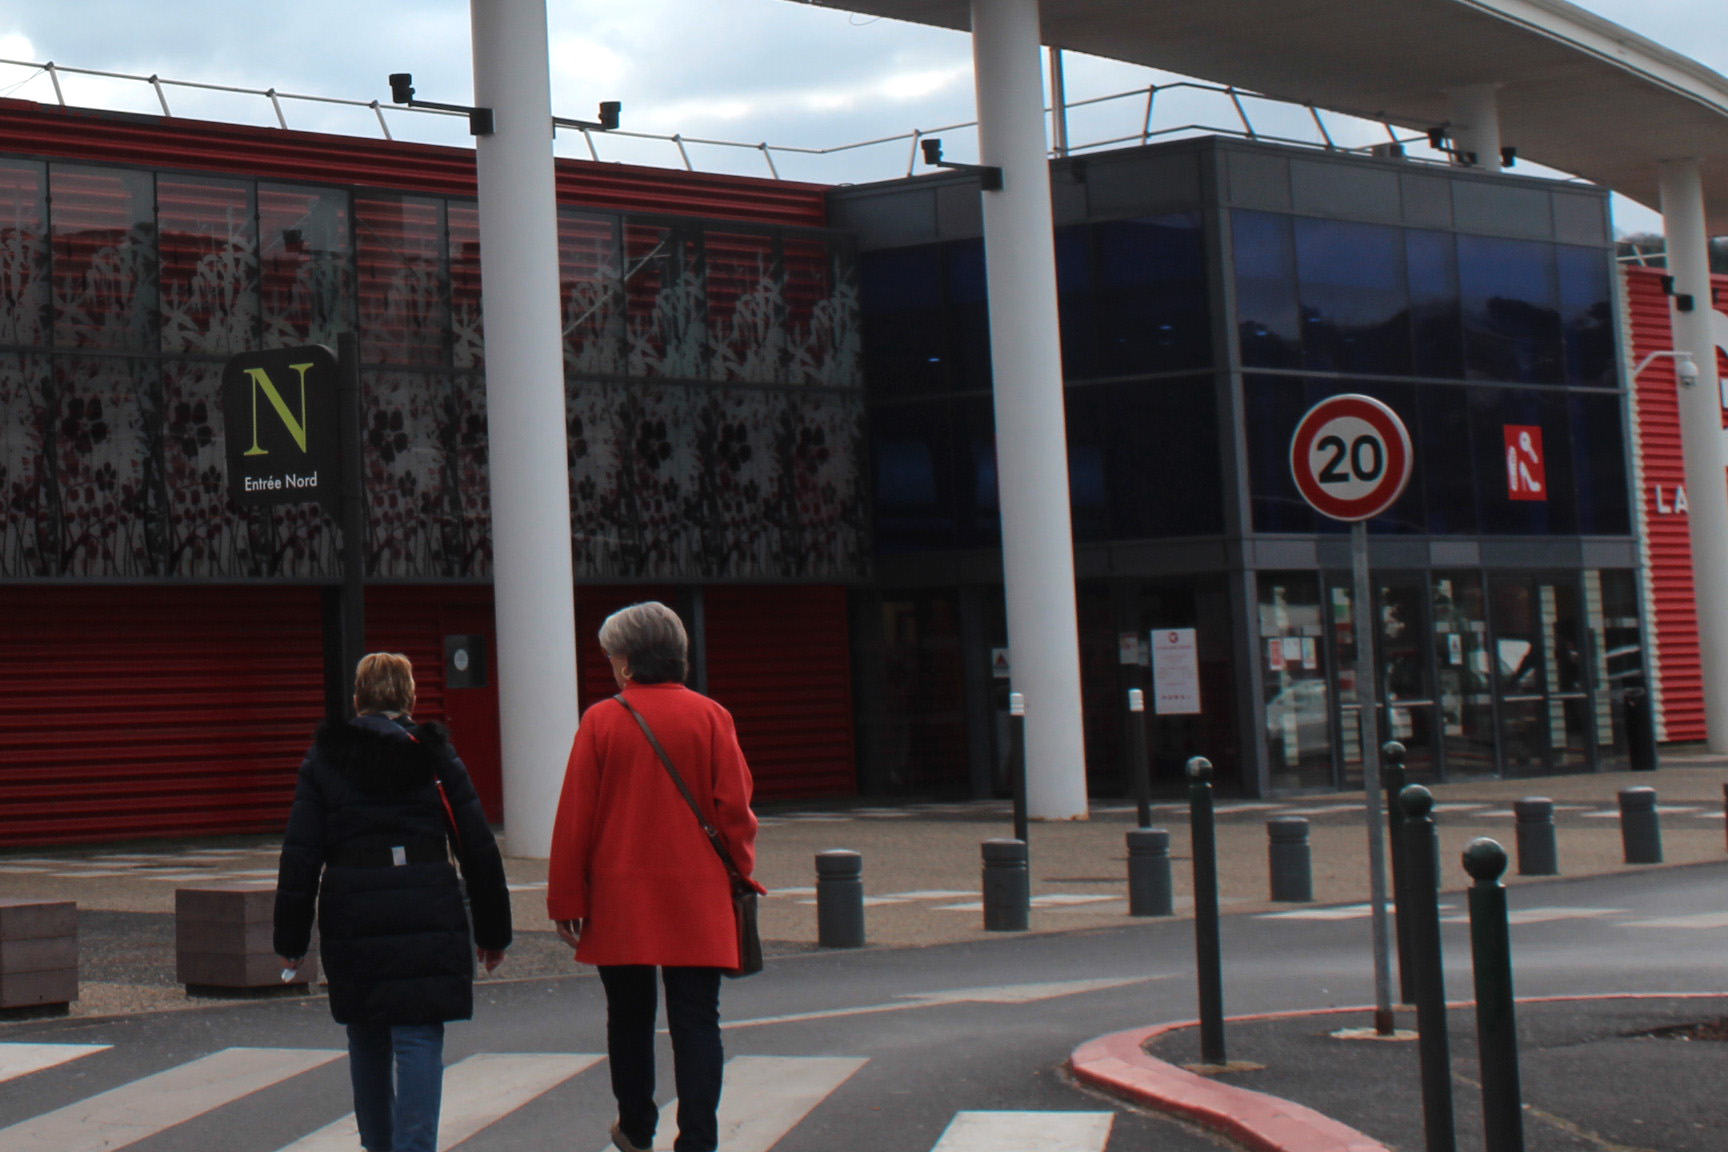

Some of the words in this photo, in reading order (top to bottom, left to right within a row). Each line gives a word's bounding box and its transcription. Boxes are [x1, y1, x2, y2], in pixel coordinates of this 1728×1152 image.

[243, 362, 314, 456] N
[245, 476, 282, 491] Entrée
[285, 471, 317, 488] Nord
[1316, 434, 1384, 484] 20
